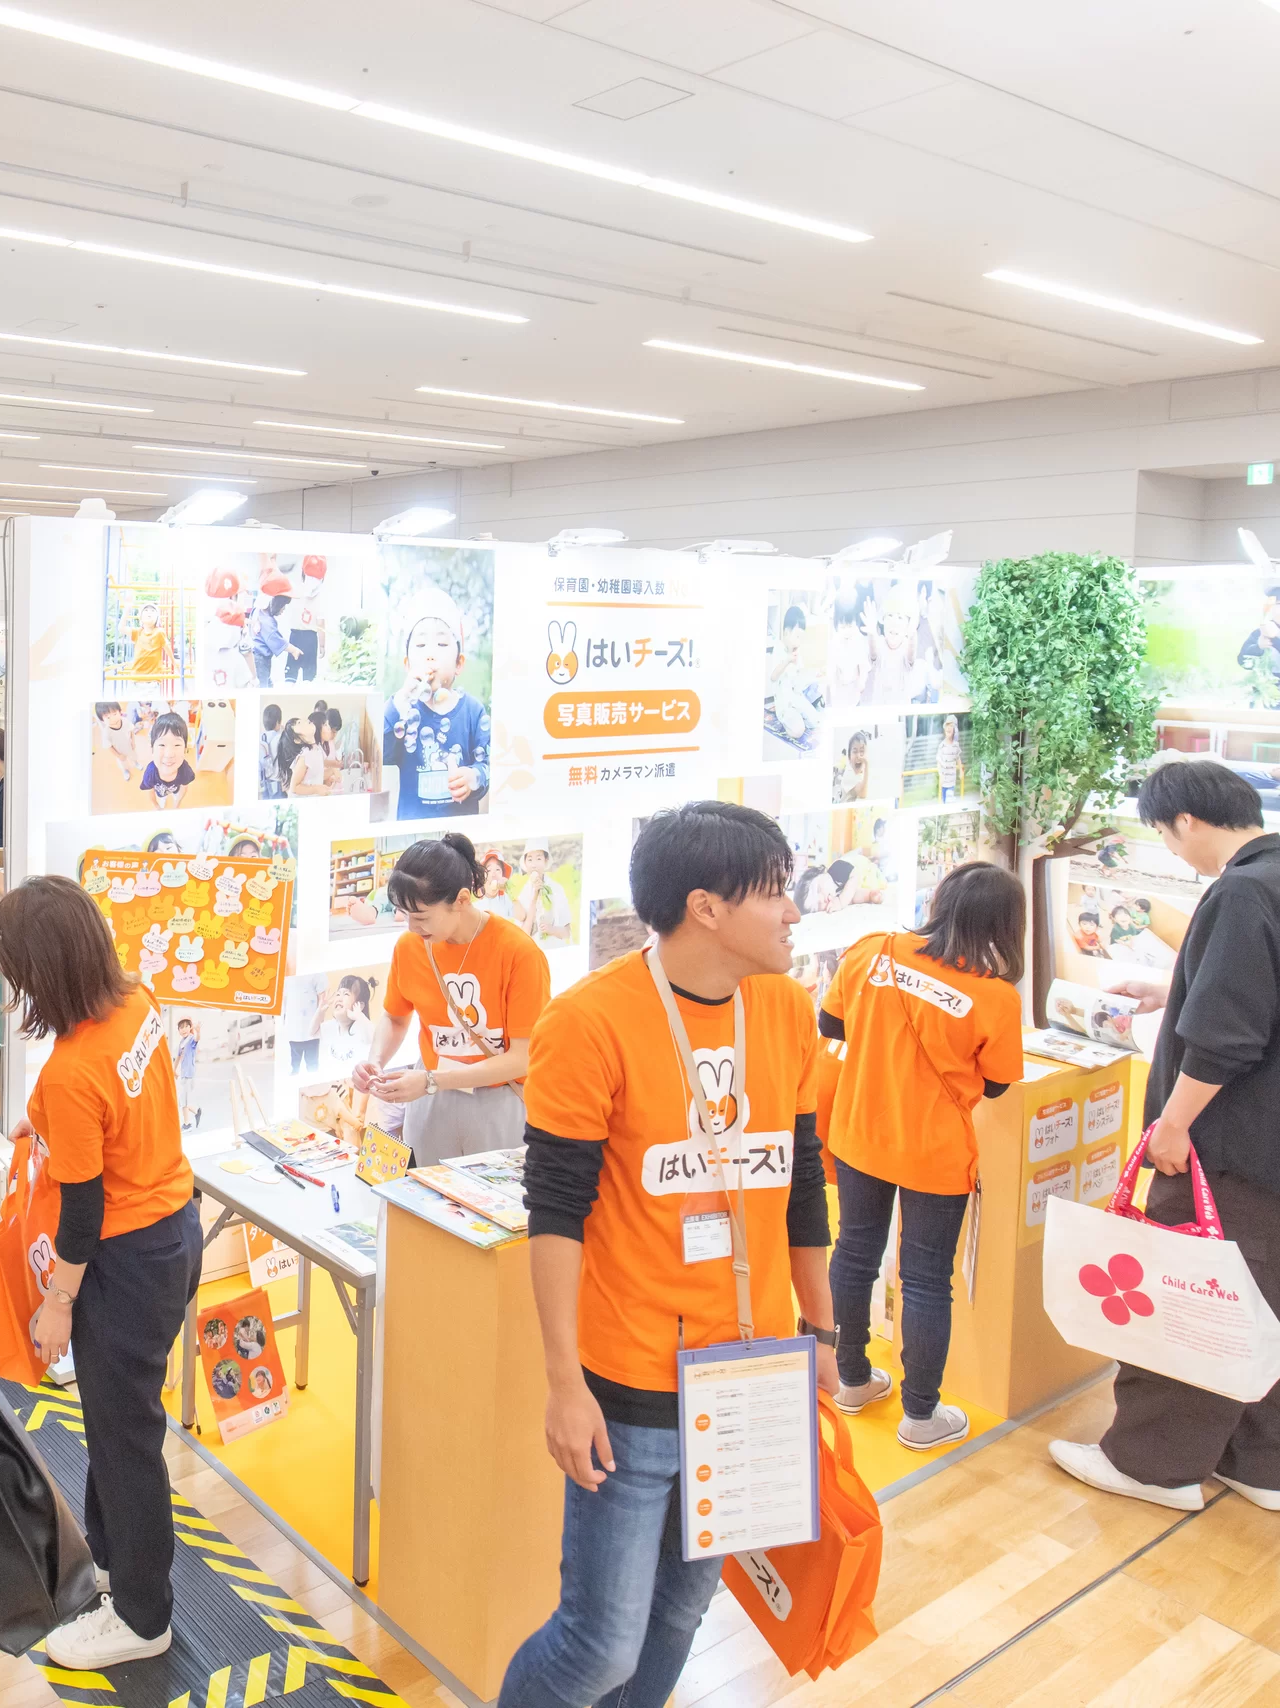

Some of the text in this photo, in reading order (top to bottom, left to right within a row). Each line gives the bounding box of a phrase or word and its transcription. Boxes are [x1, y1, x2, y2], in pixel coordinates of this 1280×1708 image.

[554, 577, 665, 595] 保育園・幼稚園導入数
[586, 637, 694, 668] はいチーズ!
[557, 699, 691, 727] 写真販売サービス
[568, 762, 676, 786] 無料 カメラマン派遣
[1044, 1116, 1073, 1135] はいチーズ!
[1162, 1275, 1239, 1301] Child Care Web
